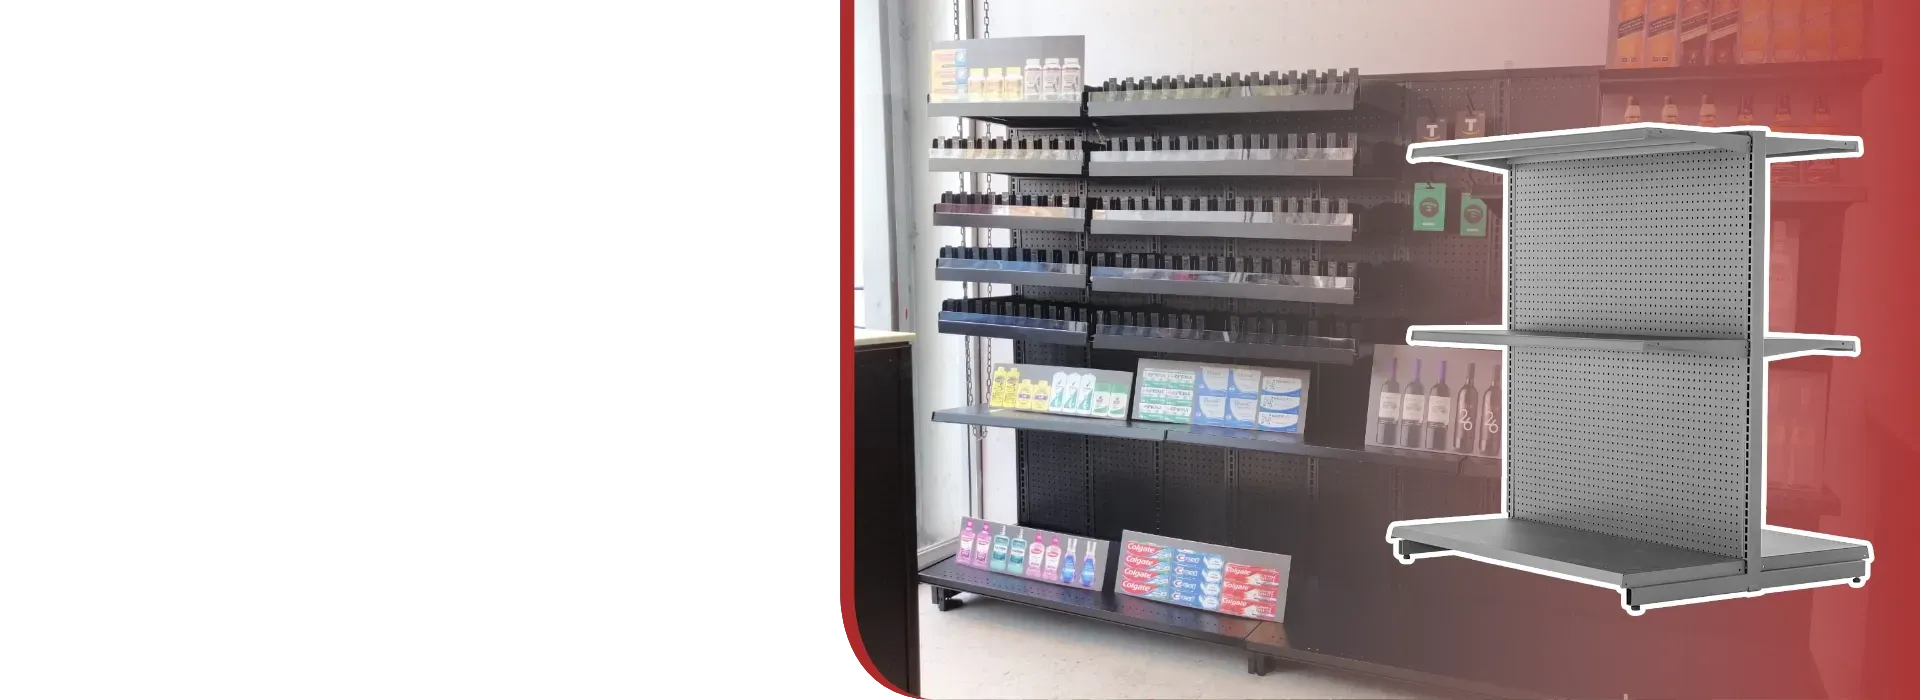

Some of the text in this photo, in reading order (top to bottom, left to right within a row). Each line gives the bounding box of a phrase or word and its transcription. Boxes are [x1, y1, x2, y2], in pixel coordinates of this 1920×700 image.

[1127, 542, 1155, 554] Colgate
[1125, 555, 1153, 566] Colgate
[1124, 568, 1152, 579] Colgate
[1122, 580, 1150, 592] Colgate
